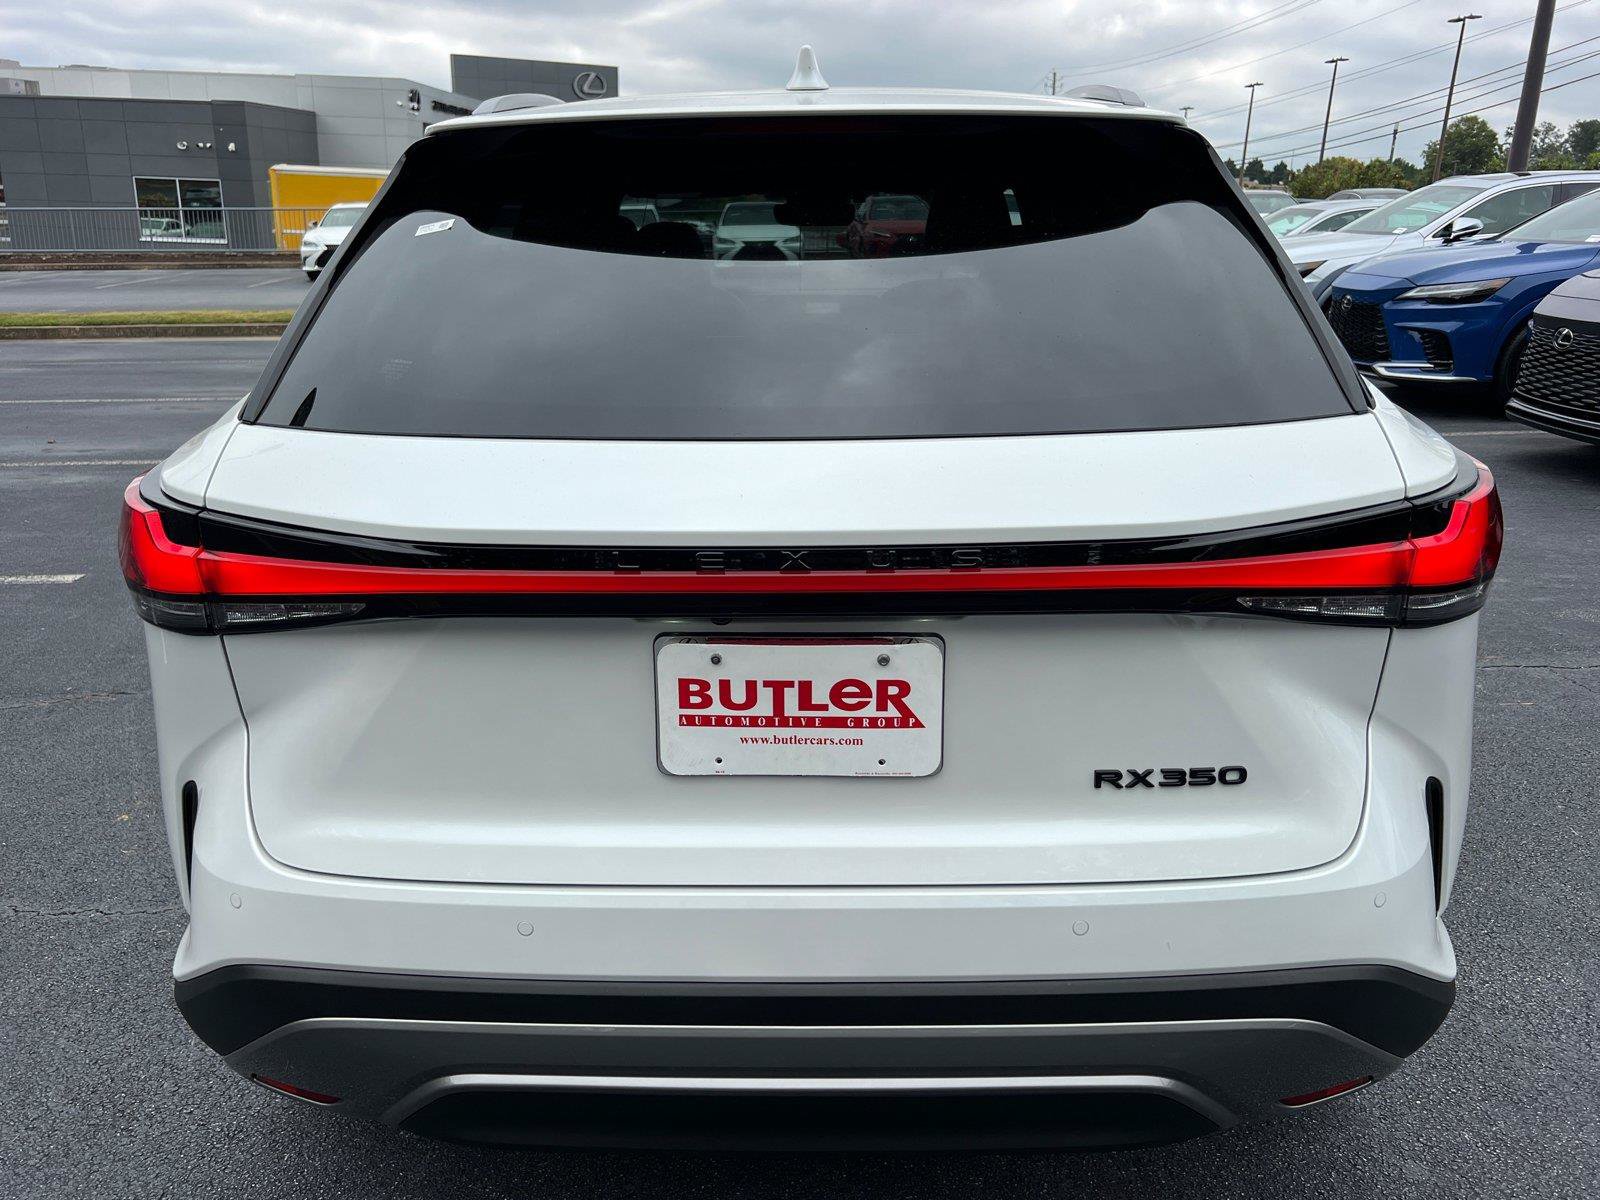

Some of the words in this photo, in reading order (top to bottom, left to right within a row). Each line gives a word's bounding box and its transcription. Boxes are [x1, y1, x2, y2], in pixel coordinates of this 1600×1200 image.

[613, 550, 983, 571] LEXUS
[680, 716, 822, 727] AUTOMOTIVE
[847, 718, 917, 728] GROUP
[739, 735, 863, 746] www.butlercars.com
[1093, 765, 1248, 789] RX350
